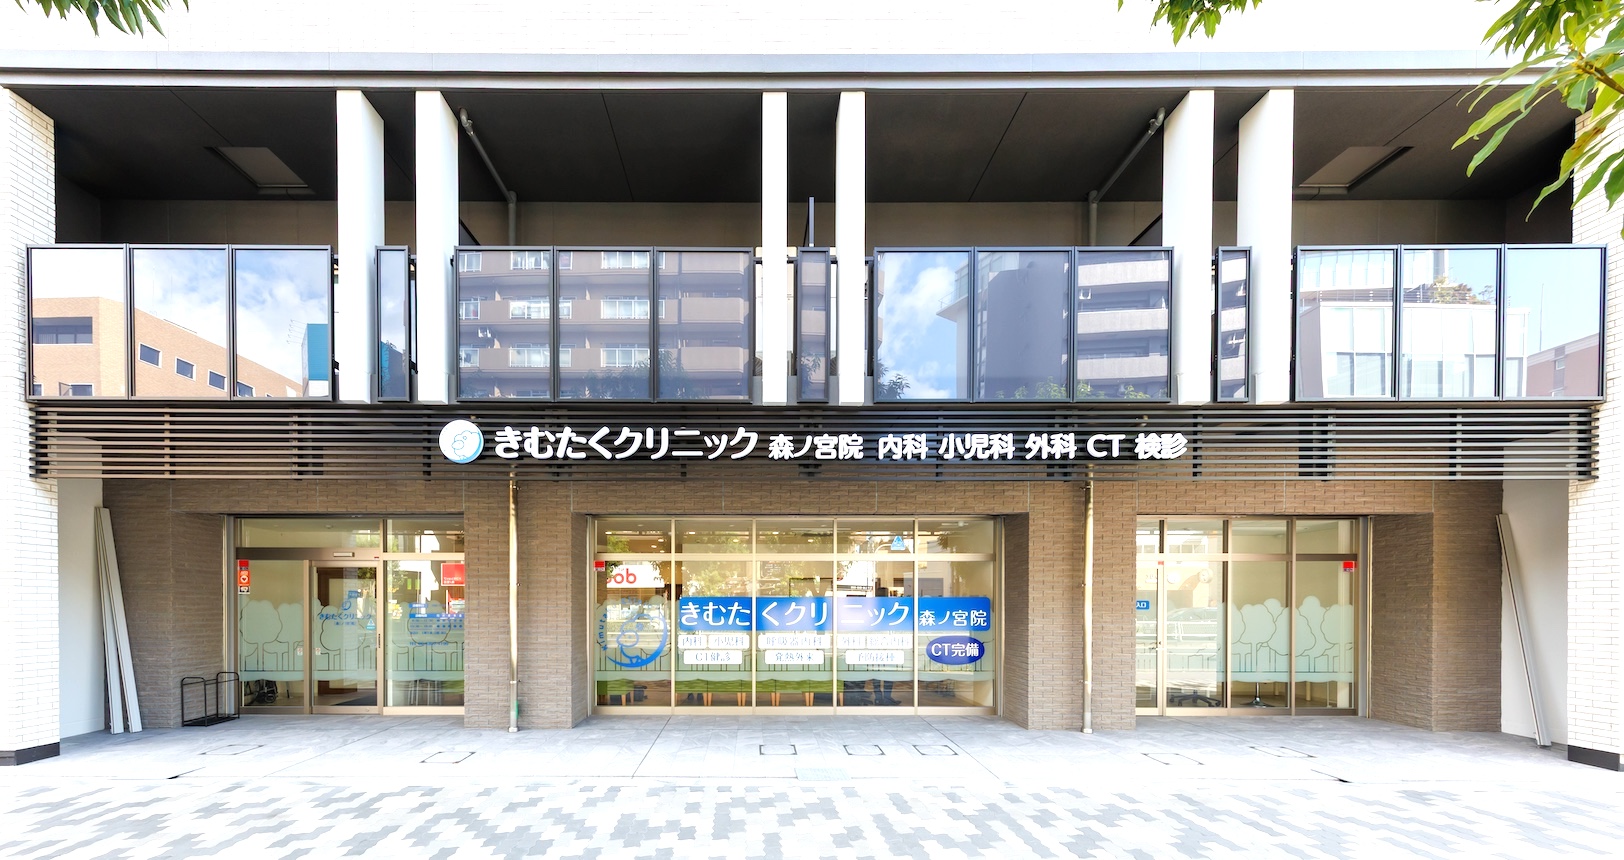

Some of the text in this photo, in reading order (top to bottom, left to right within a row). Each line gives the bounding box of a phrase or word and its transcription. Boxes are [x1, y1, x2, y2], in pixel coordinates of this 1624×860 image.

[494, 425, 759, 460] きむたくクリニック
[768, 433, 864, 460] 森ノ宮院
[878, 433, 929, 460] 内科
[938, 433, 1016, 460] 小児科
[1025, 433, 1077, 460] 外科
[1086, 433, 1126, 459] CT
[680, 601, 988, 627] きむたくクリニック 森ノ宮院
[930, 642, 980, 657] CT完備
